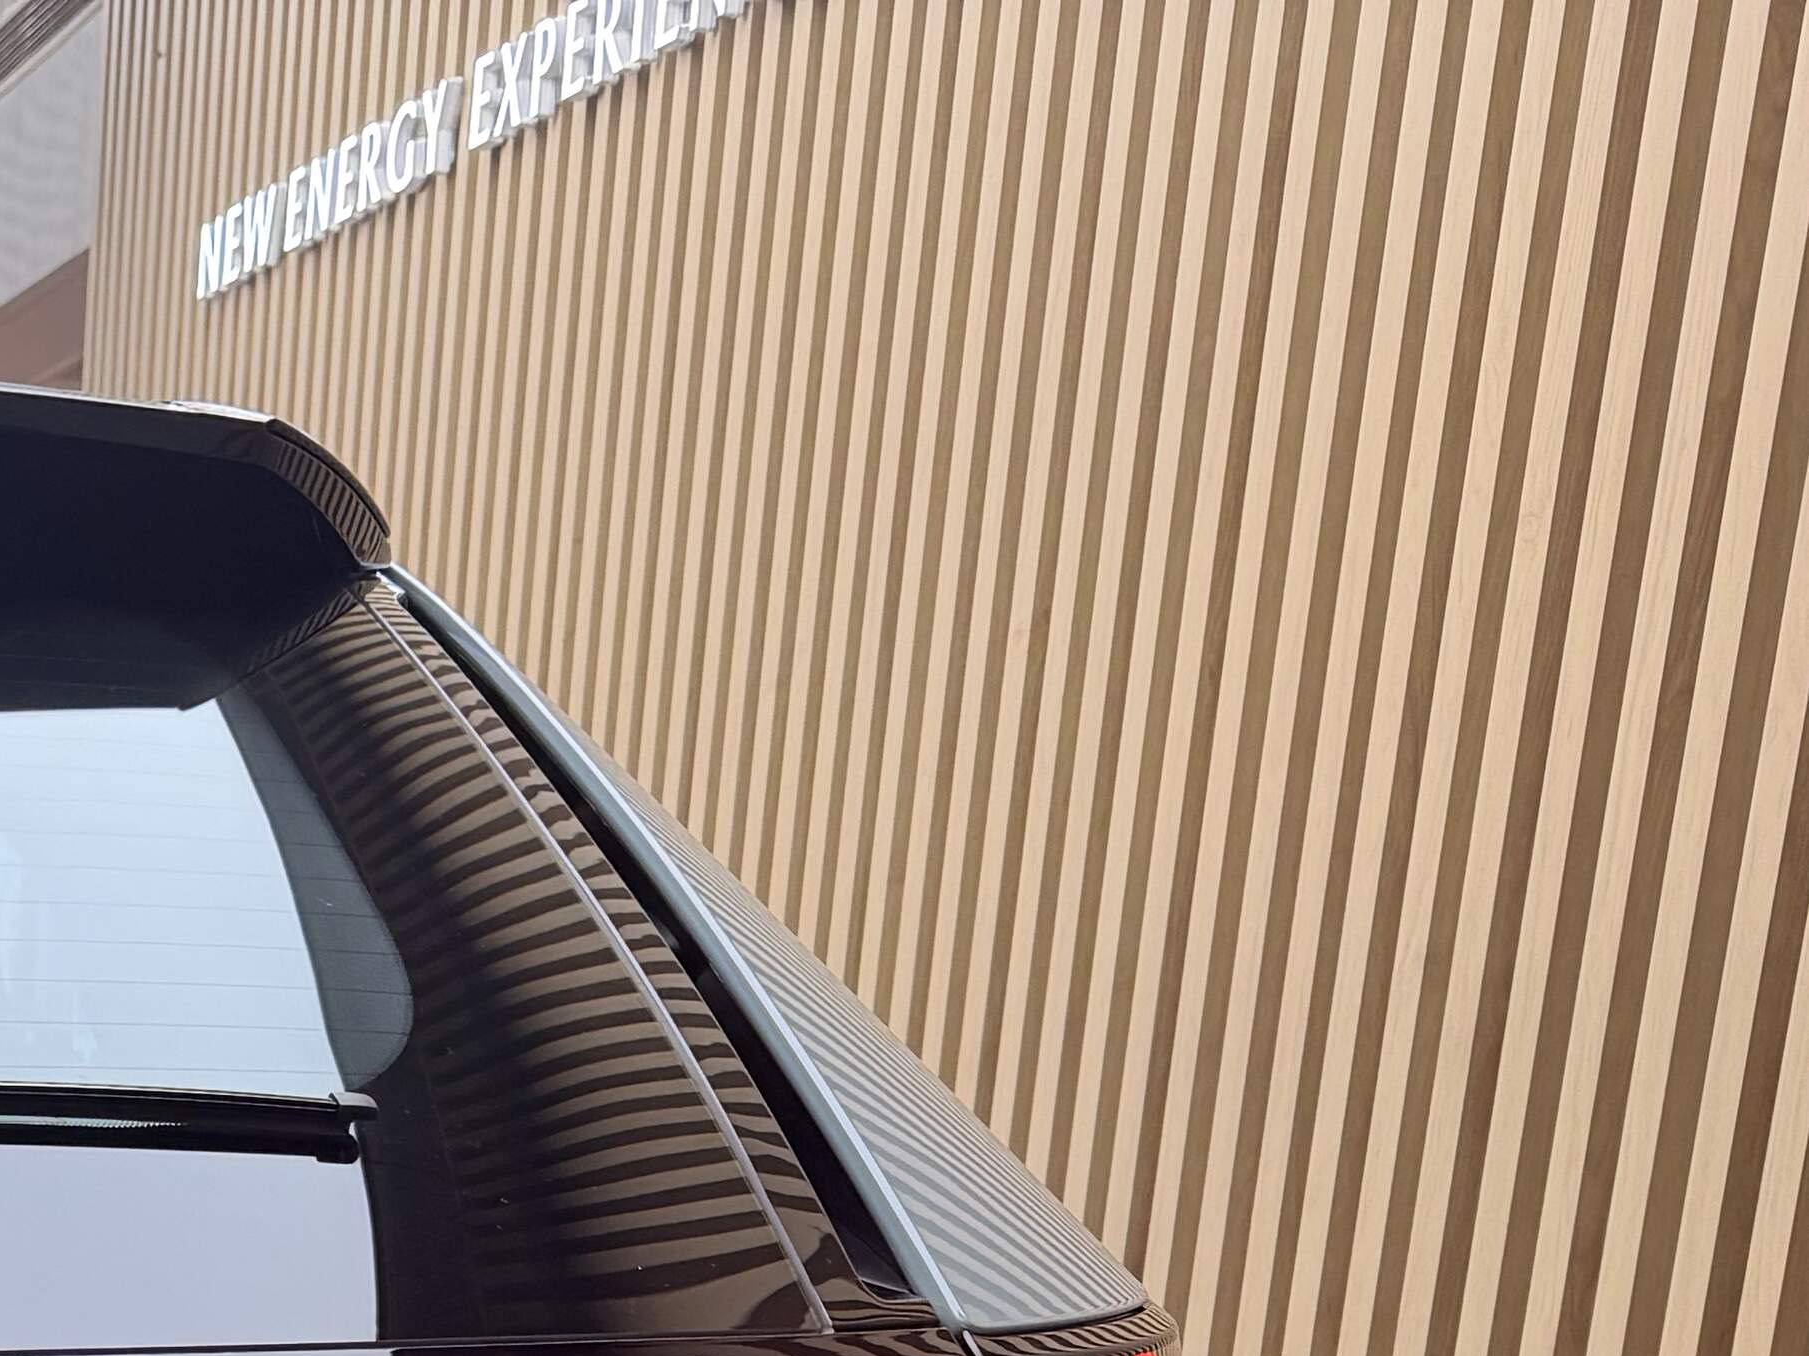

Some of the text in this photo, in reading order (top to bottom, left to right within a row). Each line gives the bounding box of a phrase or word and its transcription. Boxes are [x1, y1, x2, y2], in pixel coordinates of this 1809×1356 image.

[196, 0, 727, 300] NEW ENERGY EXPERI
